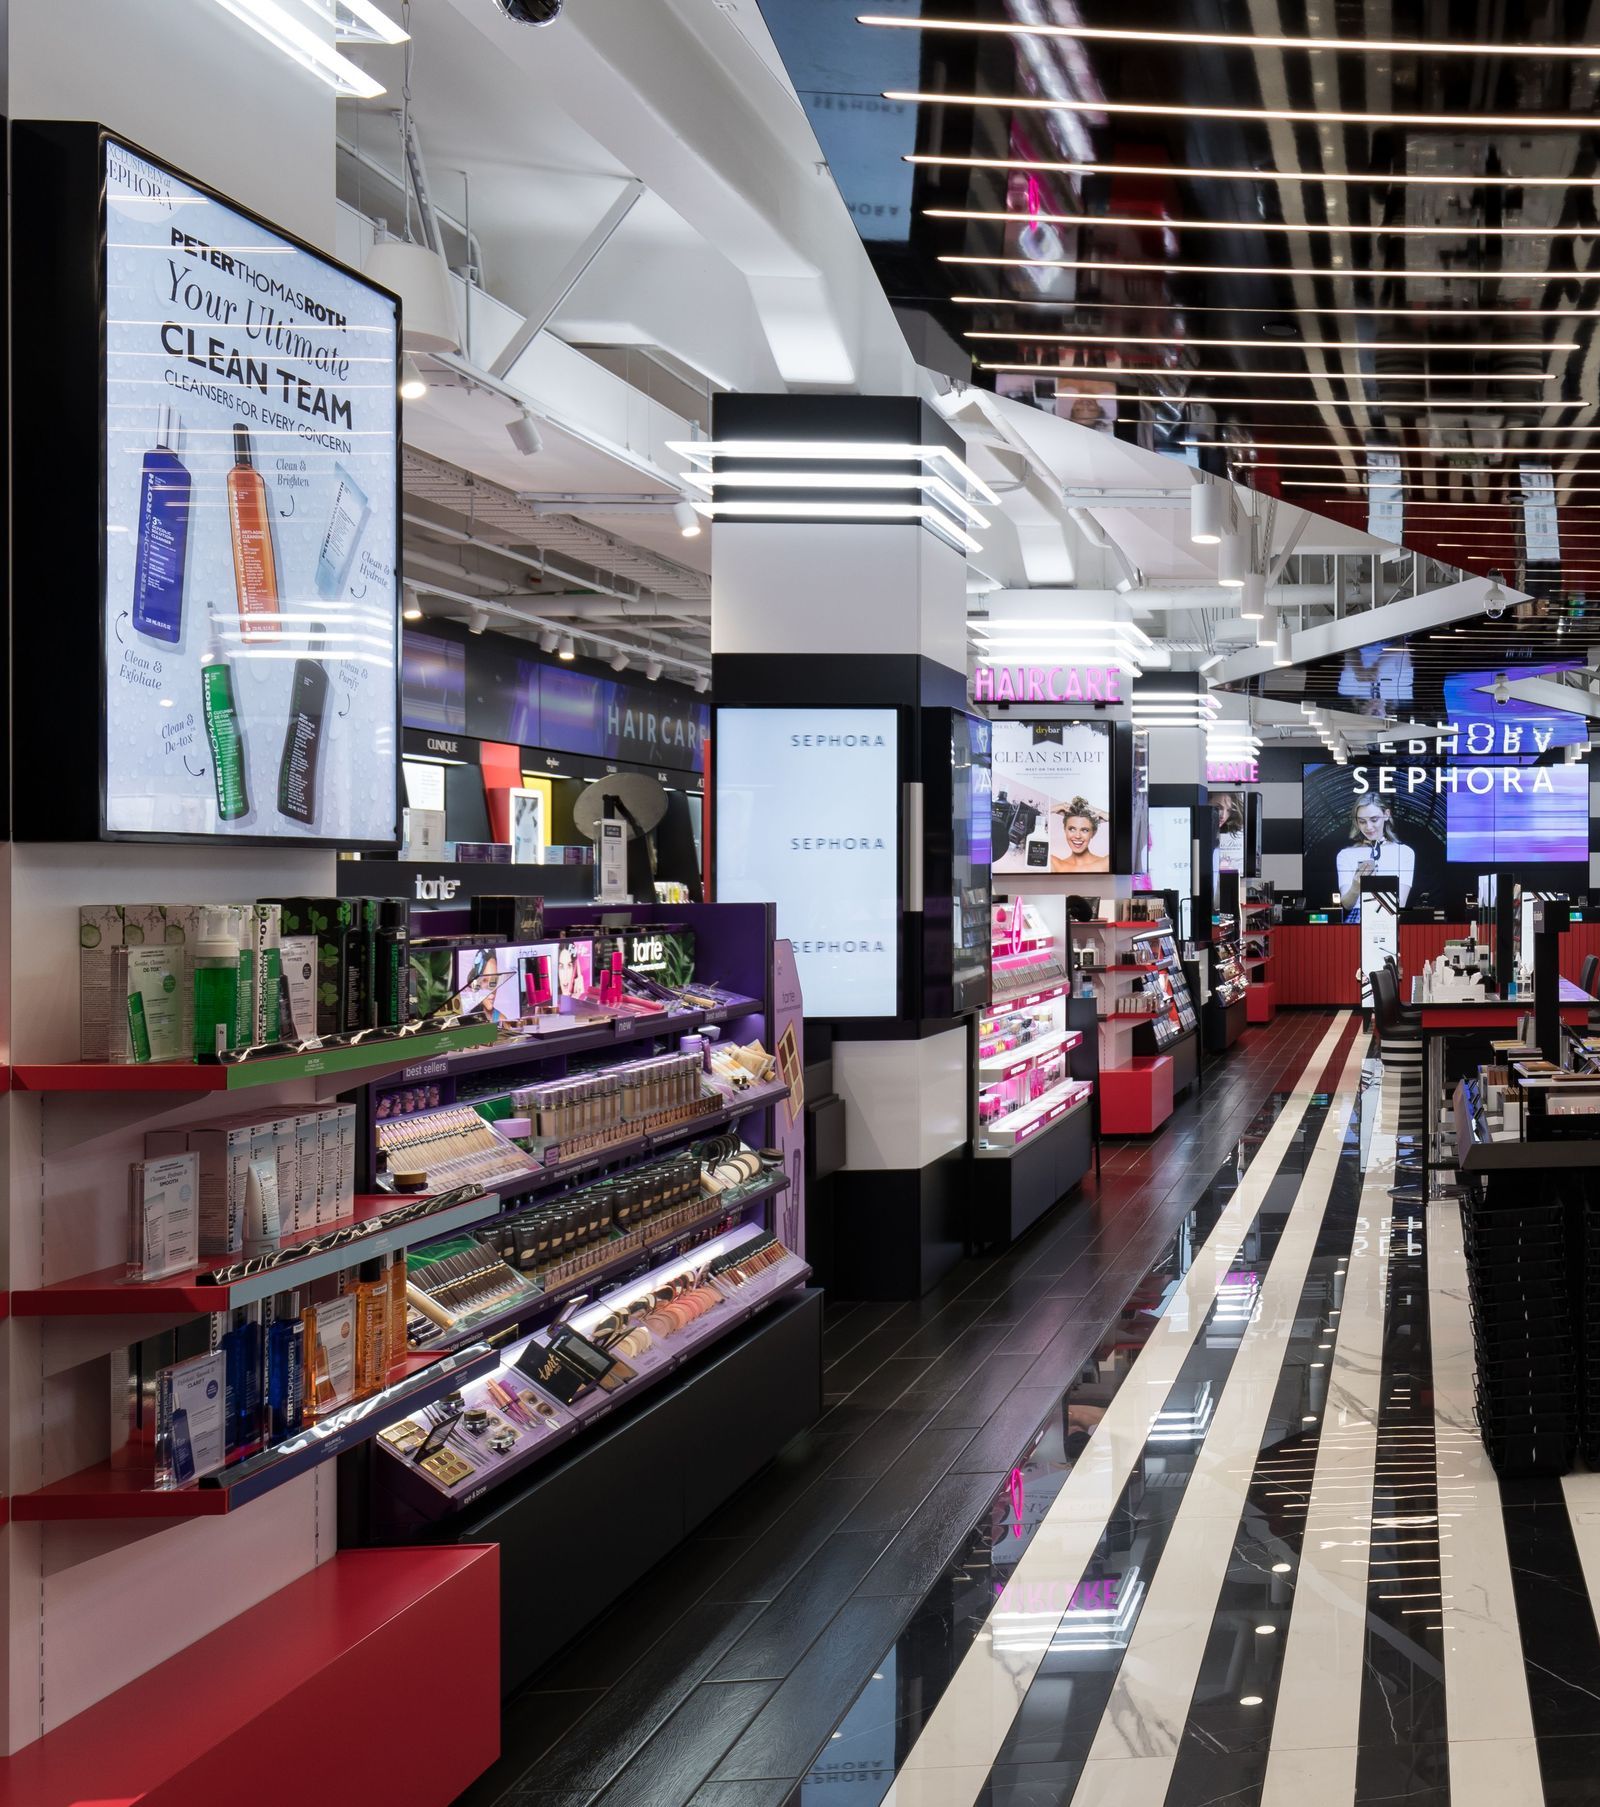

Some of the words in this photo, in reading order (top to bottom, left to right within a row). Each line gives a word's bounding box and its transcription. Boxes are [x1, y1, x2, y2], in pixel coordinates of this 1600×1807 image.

[106, 158, 174, 211] EPHORA
[167, 258, 237, 327] Your
[245, 297, 350, 381] Ultimate
[160, 320, 267, 396] CLEAN
[276, 367, 353, 430] TEAM
[164, 369, 234, 410] CLEANSERS
[235, 397, 258, 420] FOR
[262, 408, 295, 433] EVERY
[297, 423, 352, 456] CONCERN
[275, 458, 297, 472] Clean
[277, 474, 309, 488] Brighten
[359, 563, 389, 589] Hydrate
[124, 649, 152, 668] Clean
[119, 664, 162, 691] Exfoliate
[975, 667, 1121, 702] HAIRCARE
[161, 719, 185, 739] Clean
[1035, 726, 1061, 736] drybar
[427, 738, 458, 754] CLINIQUE
[791, 734, 886, 747] SEPHORA
[994, 751, 1047, 764] CLEAN
[1053, 751, 1104, 764] START
[1352, 766, 1555, 795] SEPHORA
[790, 837, 886, 850] SEPHORA
[415, 873, 458, 900] tarte
[633, 938, 663, 962] tarte
[792, 940, 885, 953] SEPHORA
[618, 1020, 632, 1032] new
[406, 1065, 422, 1078] best
[424, 1061, 446, 1075] sellers
